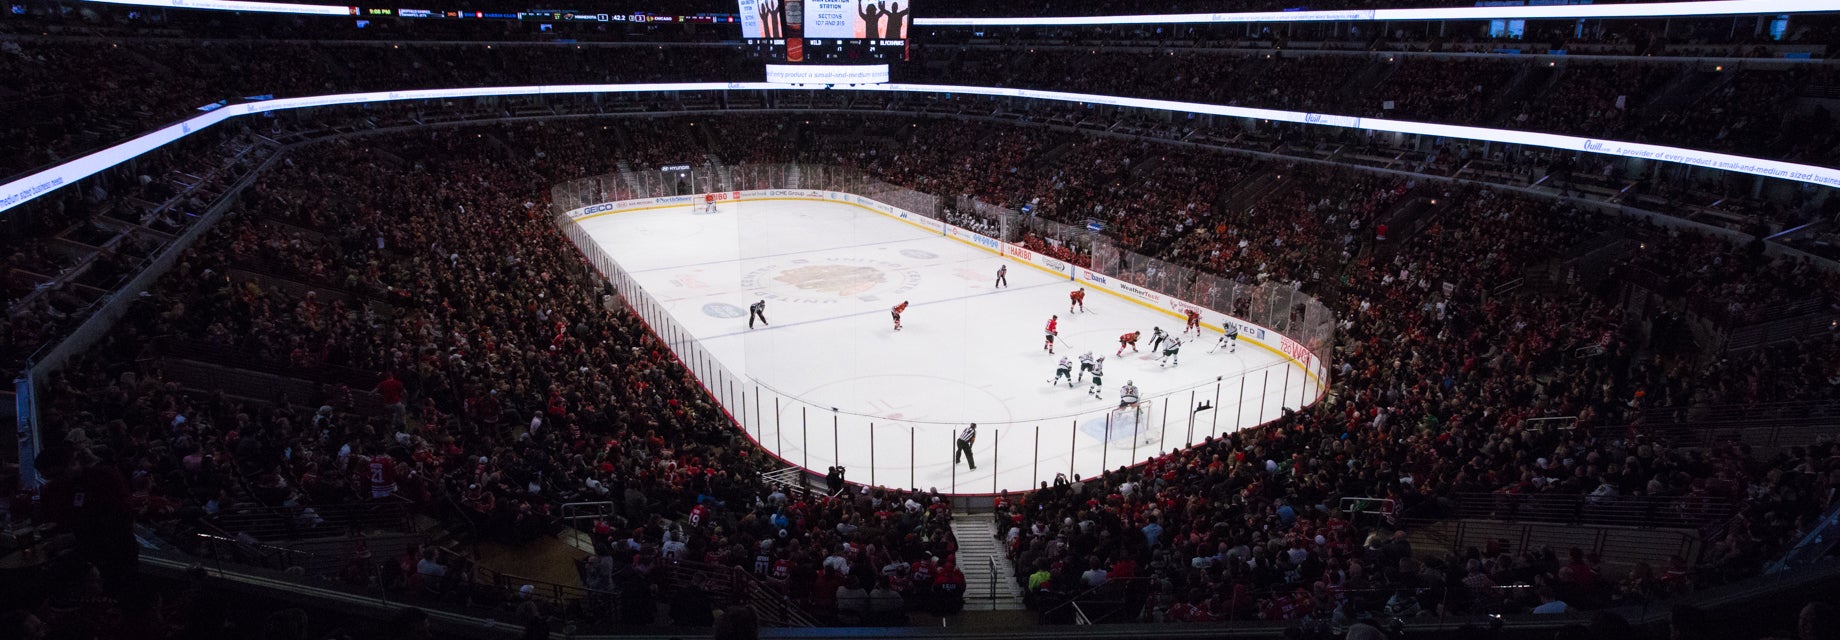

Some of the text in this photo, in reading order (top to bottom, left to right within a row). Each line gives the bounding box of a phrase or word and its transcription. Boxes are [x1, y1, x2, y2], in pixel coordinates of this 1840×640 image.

[1623, 148, 1653, 157] provider
[1665, 154, 1685, 162] every
[1686, 157, 1711, 165] product
[1791, 171, 1812, 180] sized
[584, 204, 613, 215] GEICO
[1010, 247, 1032, 261] HARIBO
[1091, 272, 1106, 284] bank
[1120, 283, 1159, 300] WeatherTech
[1280, 341, 1292, 353] 720
